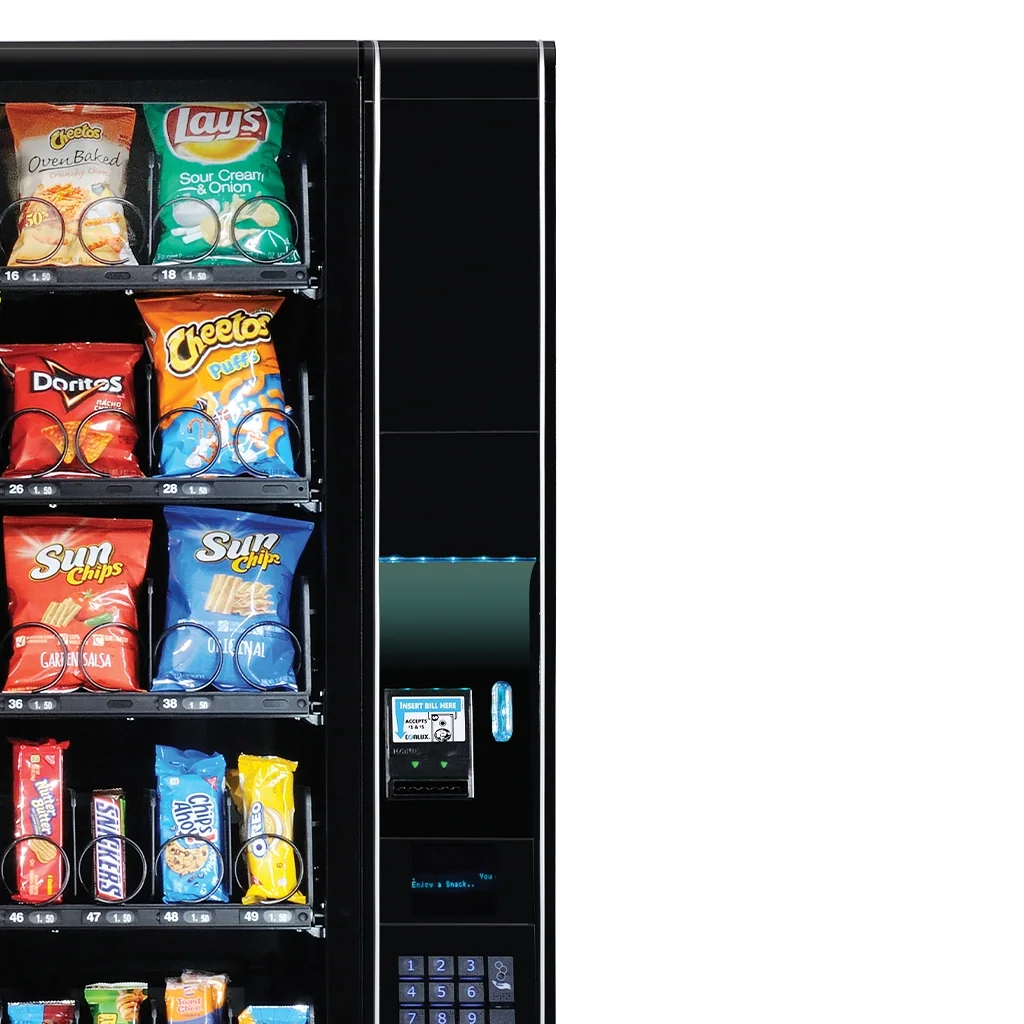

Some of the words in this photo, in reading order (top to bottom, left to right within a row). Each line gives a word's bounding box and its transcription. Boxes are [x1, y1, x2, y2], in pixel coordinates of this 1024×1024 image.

[174, 107, 263, 144] Lay's
[49, 123, 102, 150] Cheetos
[29, 155, 74, 173] Oven
[74, 149, 123, 168] Baked
[180, 171, 214, 186] Sour
[218, 169, 264, 183] Cream
[197, 183, 208, 195] &
[209, 182, 252, 193] Onion
[5, 271, 20, 281] 16
[162, 270, 177, 280] 18
[167, 310, 272, 373] Cheetos
[33, 372, 123, 393] Doritos
[9, 484, 25, 495] 26
[163, 484, 178, 494] 28
[195, 531, 280, 563] Sun
[30, 542, 113, 580] Sun
[231, 549, 281, 574] Chips
[66, 562, 124, 586] Chips
[82, 652, 112, 668] SALSA
[8, 699, 23, 709] 36
[162, 698, 178, 709] 38
[399, 702, 423, 710] INSERT
[36, 779, 56, 817] Nutter
[30, 799, 52, 835] Butter
[249, 801, 268, 858] OREO
[95, 800, 122, 898] SNICKERS
[411, 880, 434, 889] Enjoy
[9, 912, 24, 923] 46
[86, 912, 102, 922] 47
[164, 911, 179, 922] 48
[244, 911, 259, 922] 49
[408, 960, 415, 972] 1
[436, 959, 446, 972] 2
[467, 959, 475, 972] 3
[407, 986, 416, 998] 4
[437, 986, 446, 998] 5
[467, 986, 476, 998] 6
[408, 1012, 416, 1024] 7
[437, 1012, 447, 1024] 8
[468, 1012, 477, 1024] 9
